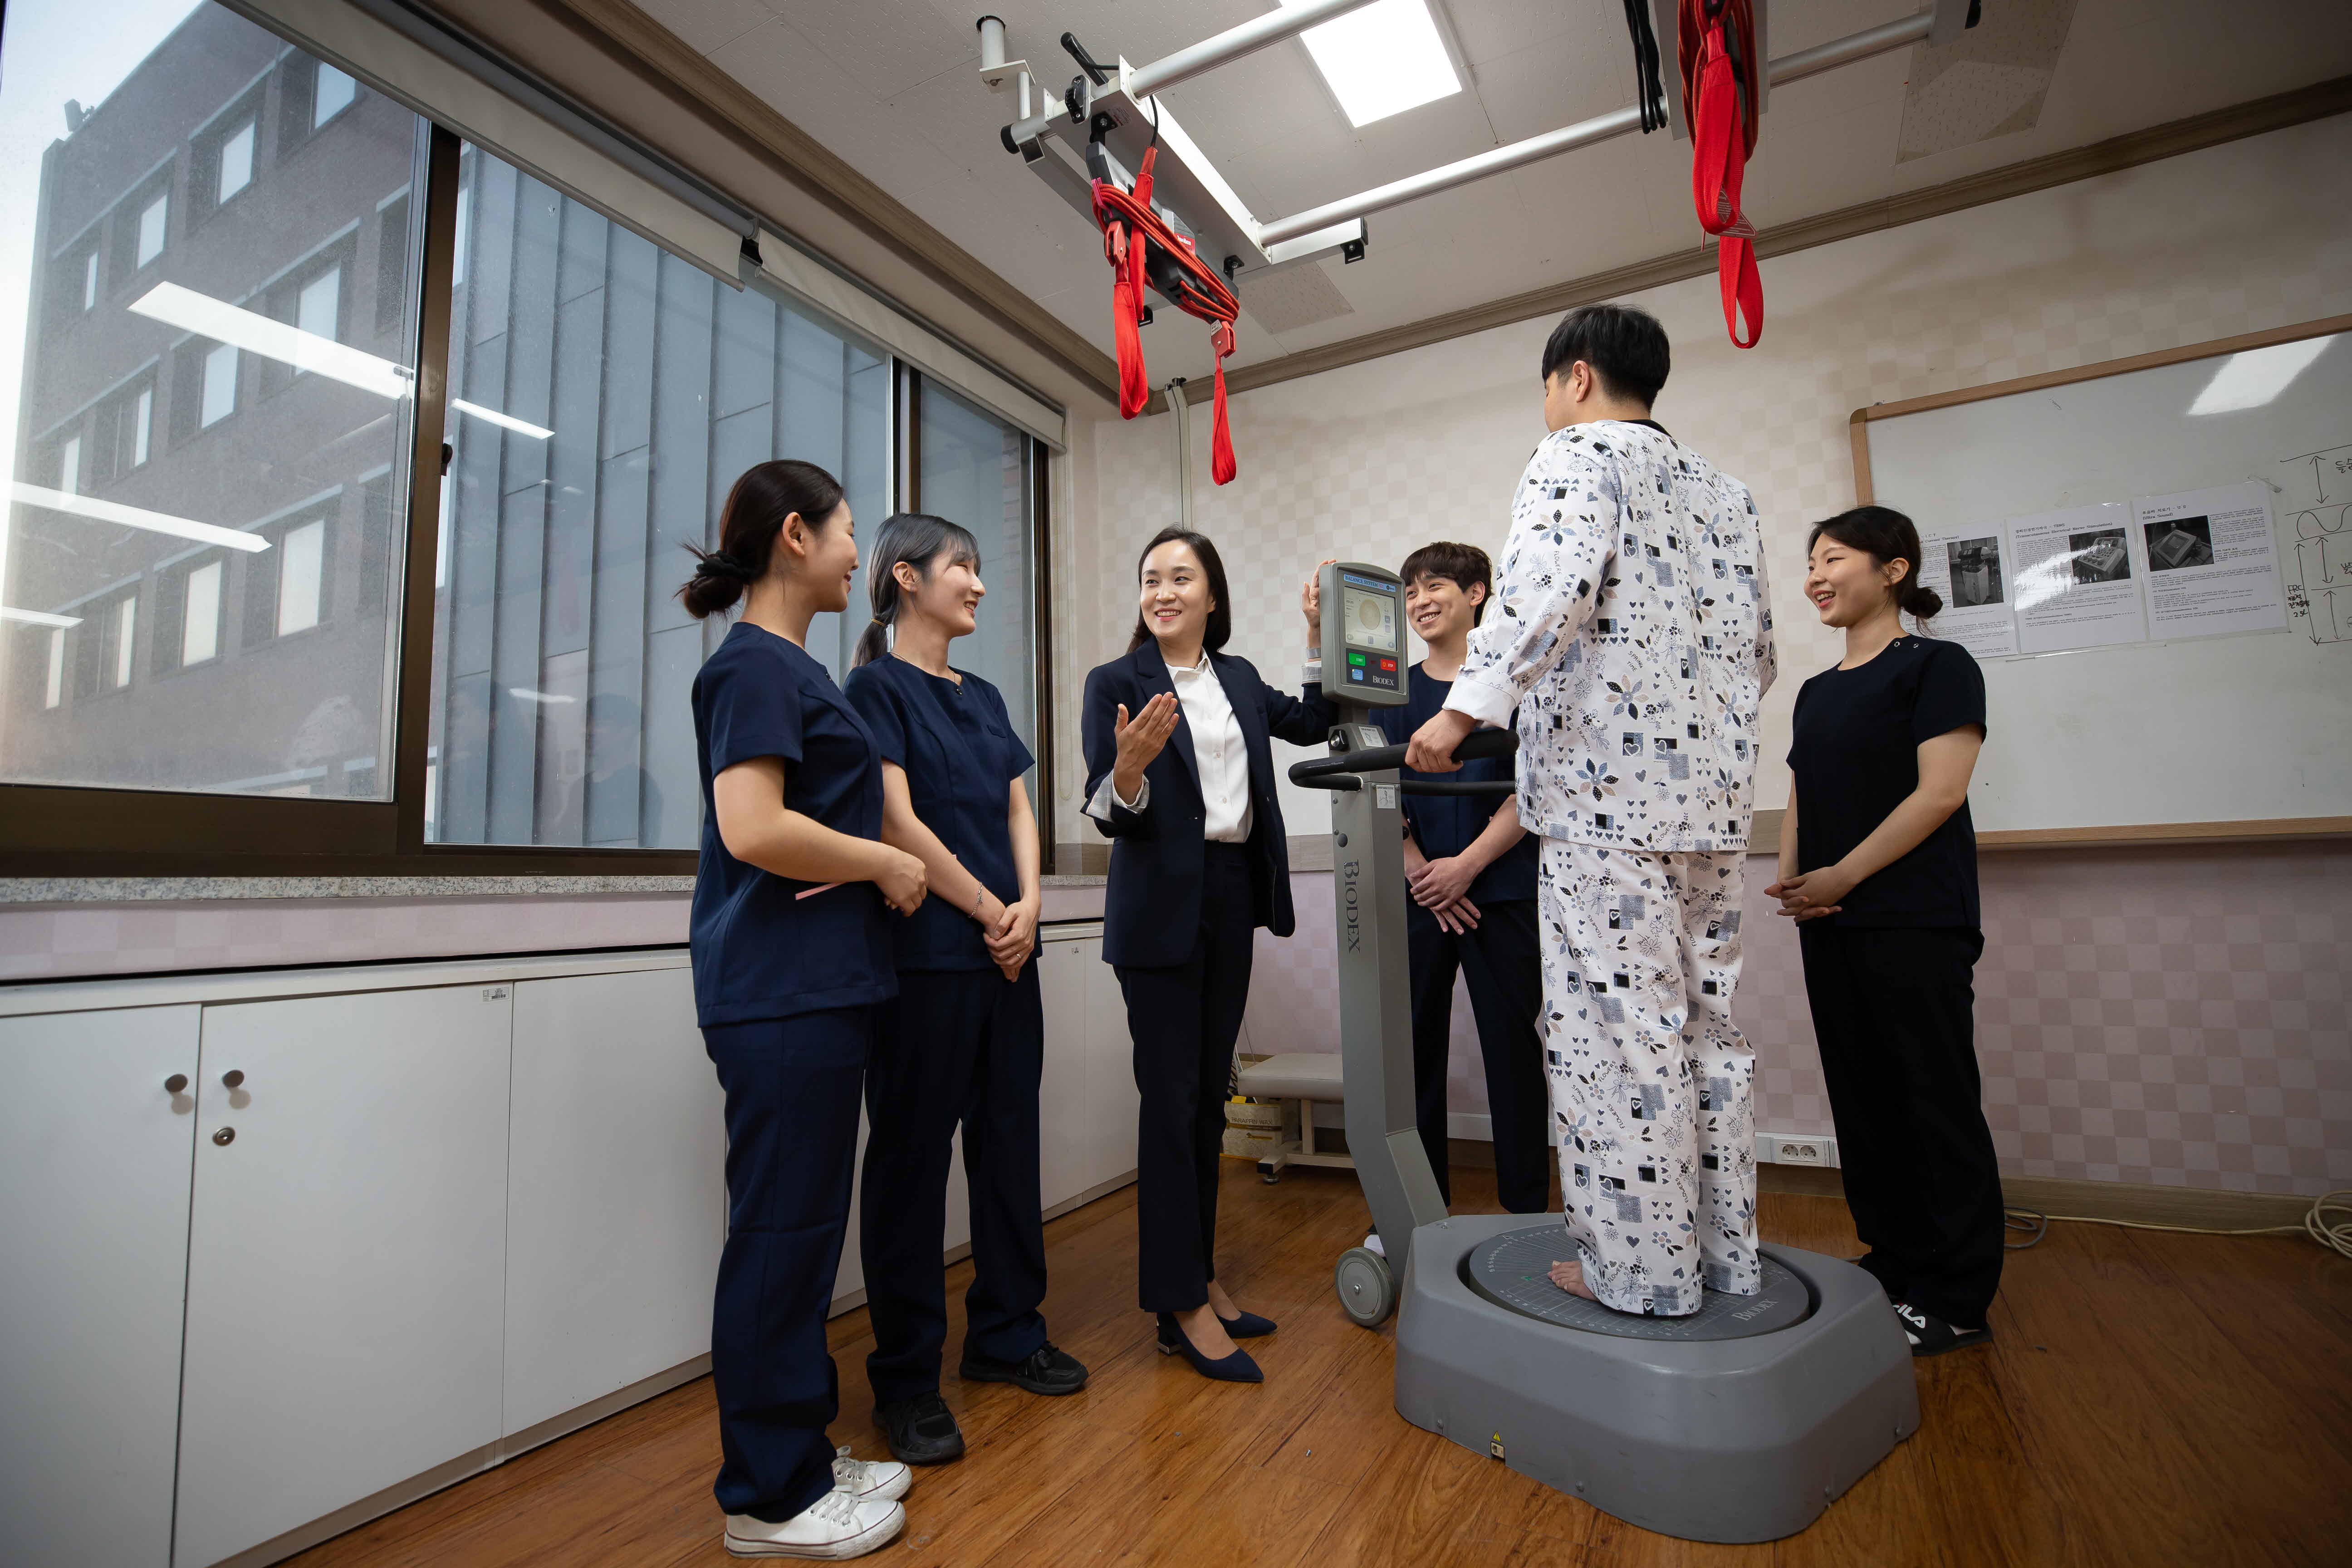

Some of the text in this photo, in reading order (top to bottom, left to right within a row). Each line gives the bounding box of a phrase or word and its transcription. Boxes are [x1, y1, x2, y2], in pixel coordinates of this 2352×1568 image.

[1345, 575, 1363, 583] BALANCE
[1363, 579, 1378, 588] SYSTEM
[2287, 584, 2304, 594] FRC
[1653, 624, 1666, 646] FLOWERS
[1627, 661, 1637, 671] TIME
[1628, 651, 1643, 668] SPRING
[1372, 675, 1394, 686] BIODEX
[1662, 666, 1677, 690] FLOWERS
[1722, 666, 1734, 682] SPRING
[1656, 820, 1675, 843] FLOWERS
[1580, 874, 1596, 894] FLOWERS
[1343, 859, 1361, 955] BIODEX
[1587, 914, 1603, 939] FLOWERS
[1648, 984, 1662, 1009] FLOWERS
[1598, 1060, 1616, 1082] FLOWERS
[1571, 1094, 1581, 1106] TIME
[1572, 1085, 1585, 1103] SPRING
[1607, 1103, 1625, 1129] FLOWERS
[1675, 1178, 1689, 1203] FLOWERS
[1607, 1261, 1626, 1283] FLOWERS
[1731, 1298, 1779, 1321] BIODEX
